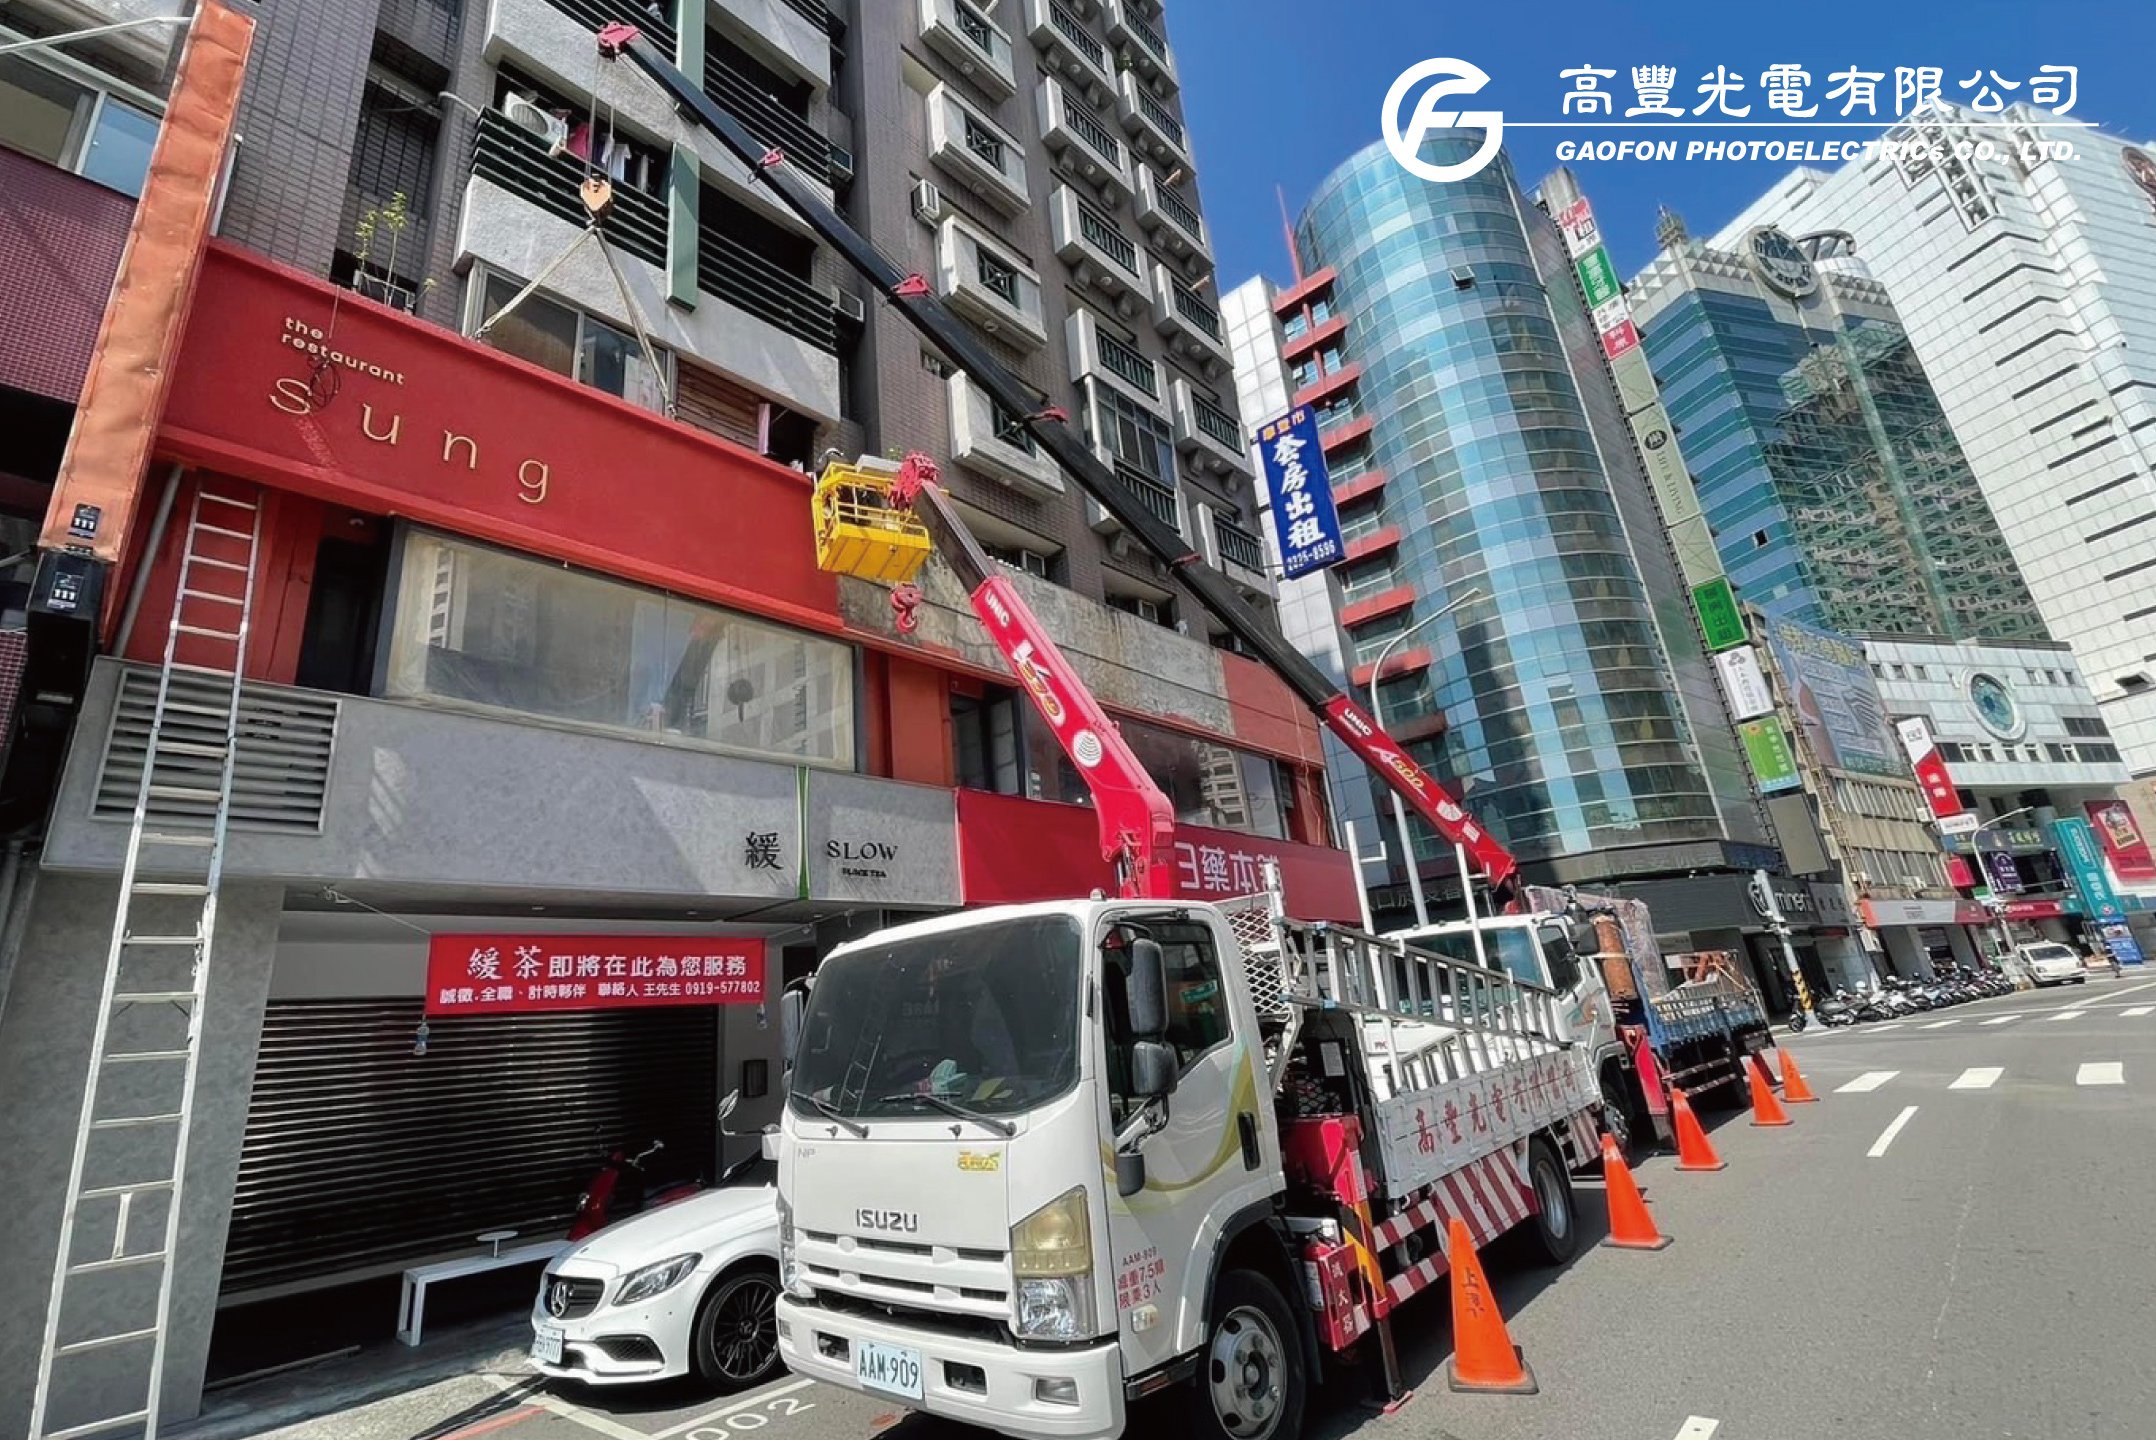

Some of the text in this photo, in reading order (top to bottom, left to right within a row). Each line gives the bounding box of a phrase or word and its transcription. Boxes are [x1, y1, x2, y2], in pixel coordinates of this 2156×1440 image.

[285, 316, 324, 340] the
[281, 333, 405, 386] restaurant
[1273, 434, 1326, 549] 套房出租
[744, 831, 784, 870] 緩
[826, 839, 898, 861] SLOW
[643, 983, 681, 997] 王先生
[856, 1208, 917, 1233] ISUZU
[860, 1348, 918, 1389] AAM-909
